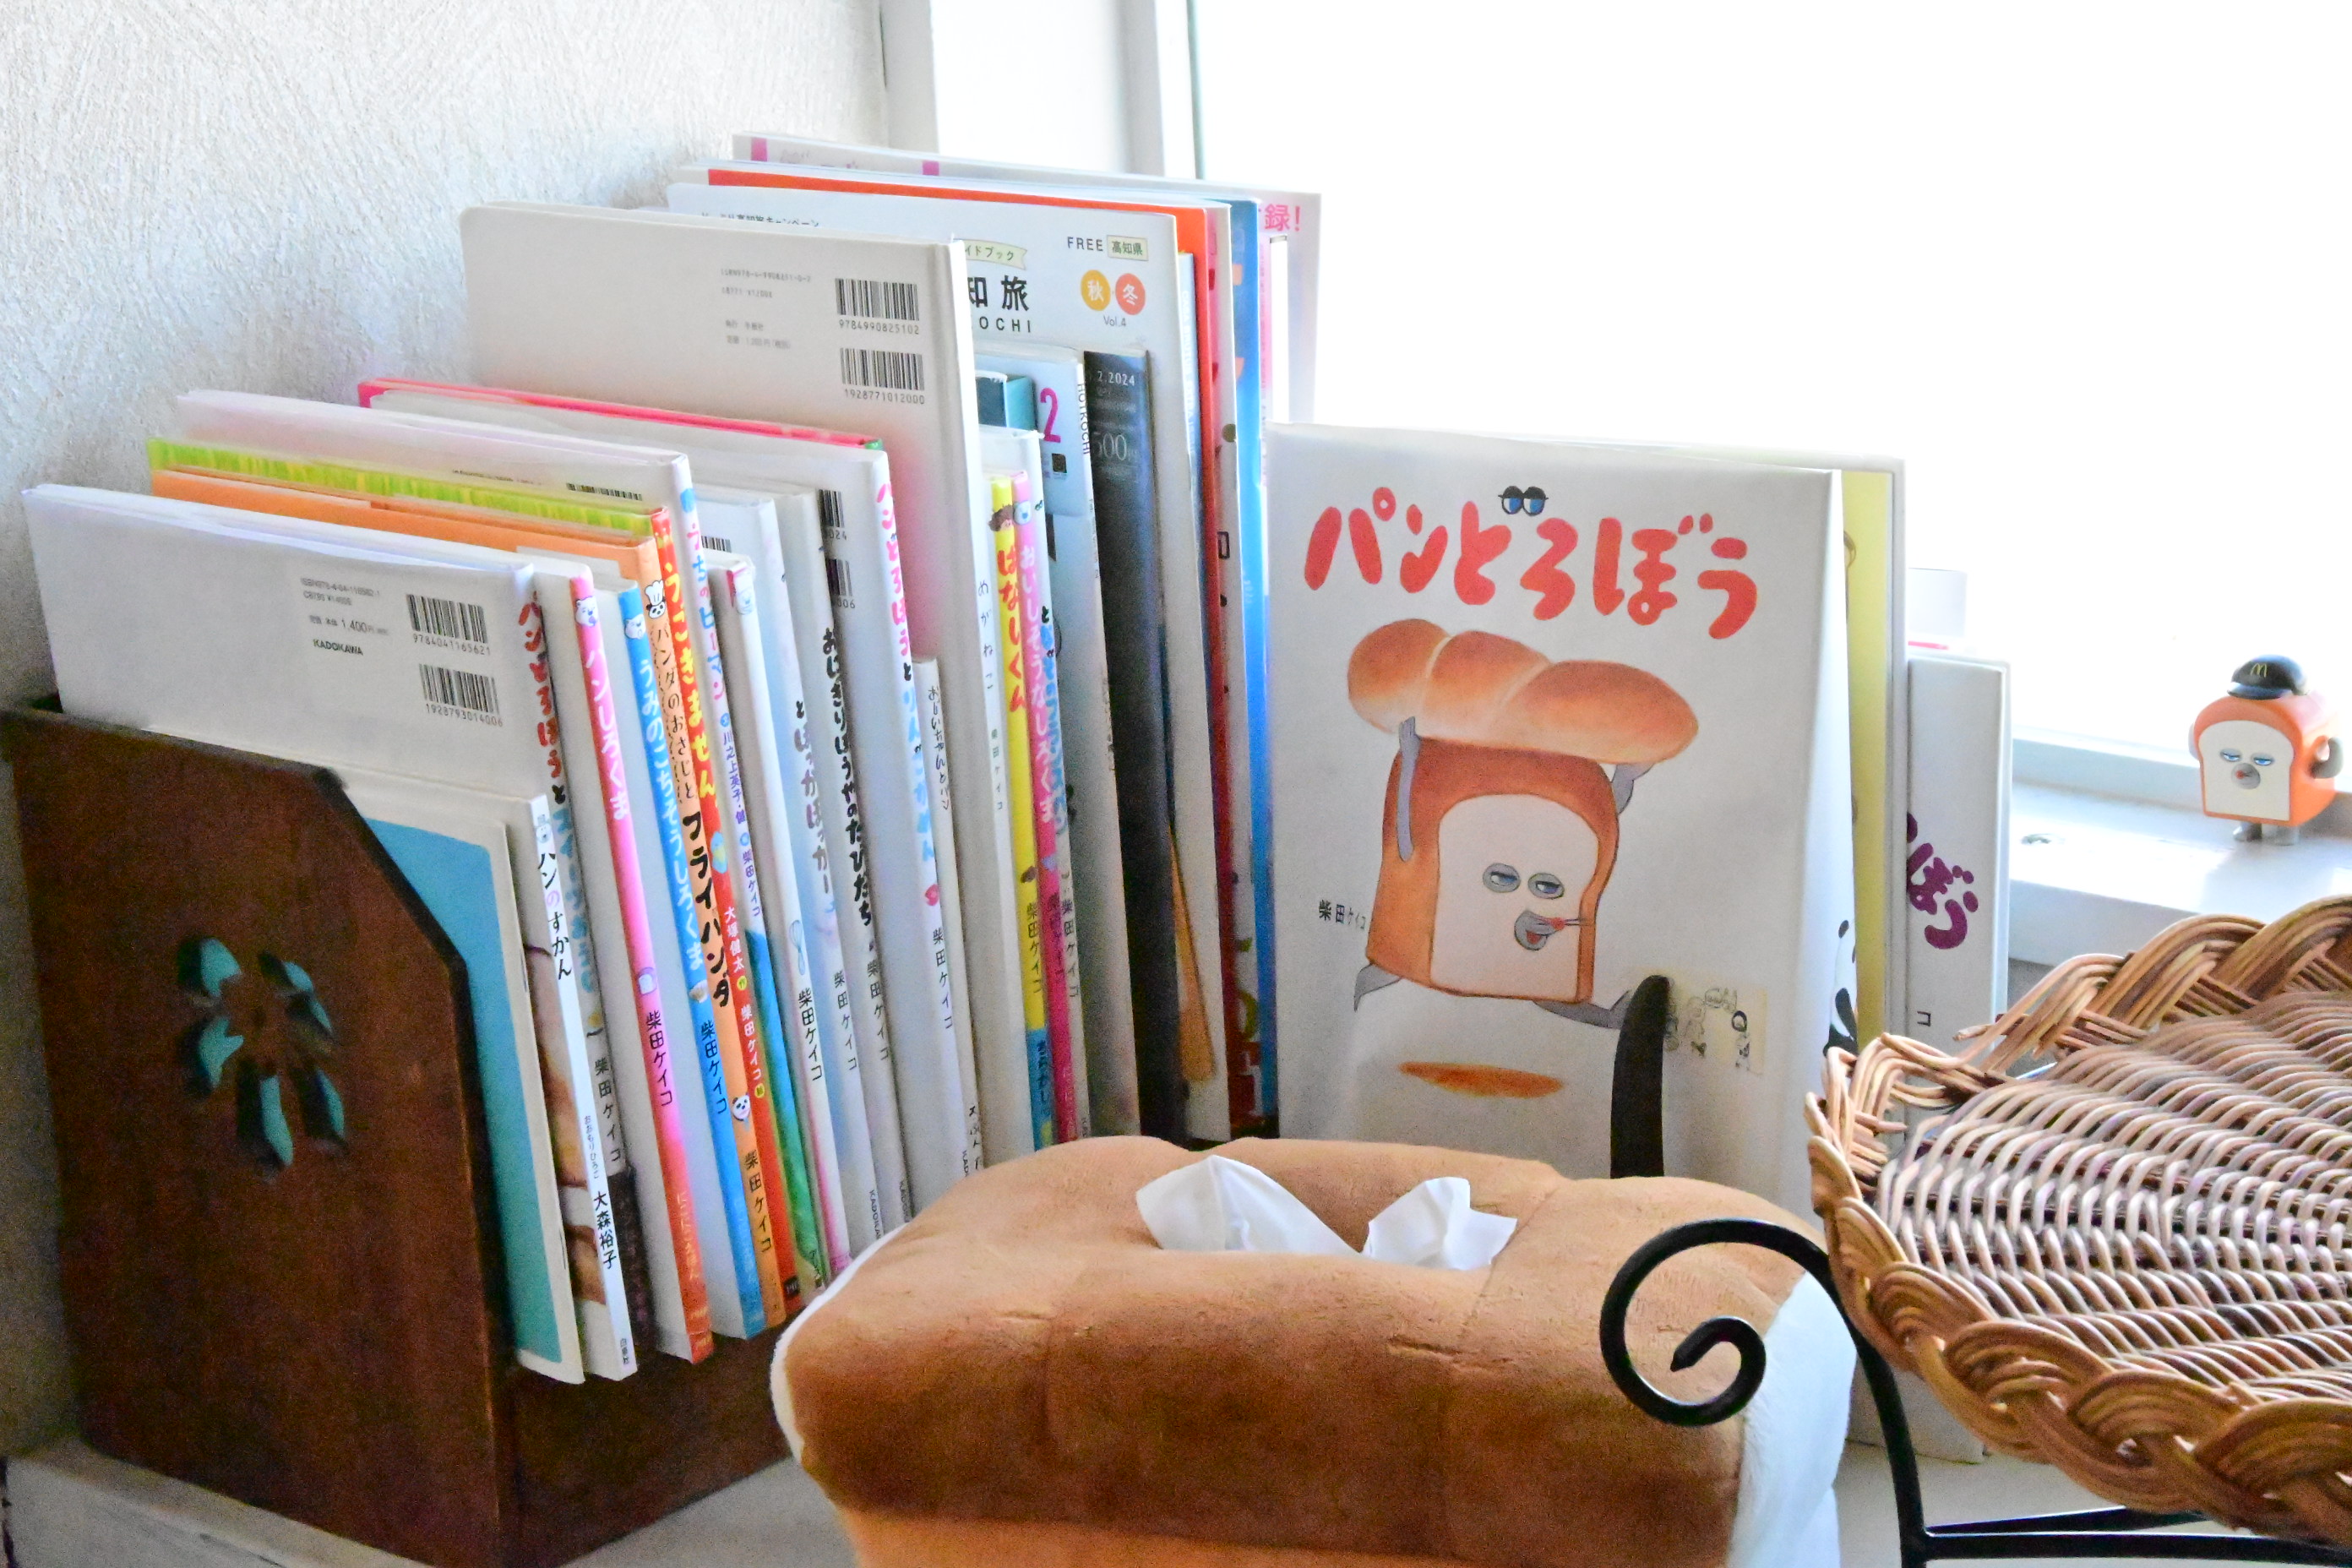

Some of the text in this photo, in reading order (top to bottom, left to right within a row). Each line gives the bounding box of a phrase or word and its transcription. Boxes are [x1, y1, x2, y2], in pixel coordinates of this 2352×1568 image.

[1067, 237, 1103, 252] FREE
[1111, 240, 1143, 256] 高知県
[1261, 204, 1301, 231] 録!
[839, 318, 920, 335] 9784990825102
[971, 316, 1032, 334] OCHI
[1086, 280, 1139, 307] 秋 冬
[1103, 314, 1127, 328] Vol.4
[845, 389, 925, 405] 1928771012000
[1040, 388, 1061, 444] 2
[1304, 487, 1757, 640] パンどろぼう
[313, 639, 363, 656] KADOKAWA
[413, 634, 491, 656] 9784041165621
[977, 580, 994, 689] めがねこ
[426, 703, 504, 727] 1928793014006
[741, 850, 760, 917] 柴田ケイコ
[1906, 813, 1979, 950] ぼう
[933, 928, 953, 1030] 柴田ケイコ
[1026, 902, 1043, 994] 柴田ケイコ
[724, 906, 746, 973] 大塚健太
[741, 1004, 762, 1081] 柴田ケイコ
[834, 970, 858, 1071] 柴田ケイコ
[867, 960, 889, 1061] 柴田ケイコ
[646, 1011, 673, 1107] 柴田ケイコ
[700, 1020, 727, 1115] 柴田ケイコ
[798, 987, 823, 1081] 柴田ケイコ
[594, 1058, 622, 1162] 柴田ケイコ
[593, 1190, 618, 1270] 大森裕子
[745, 1150, 771, 1253] 柴田ケイコ
